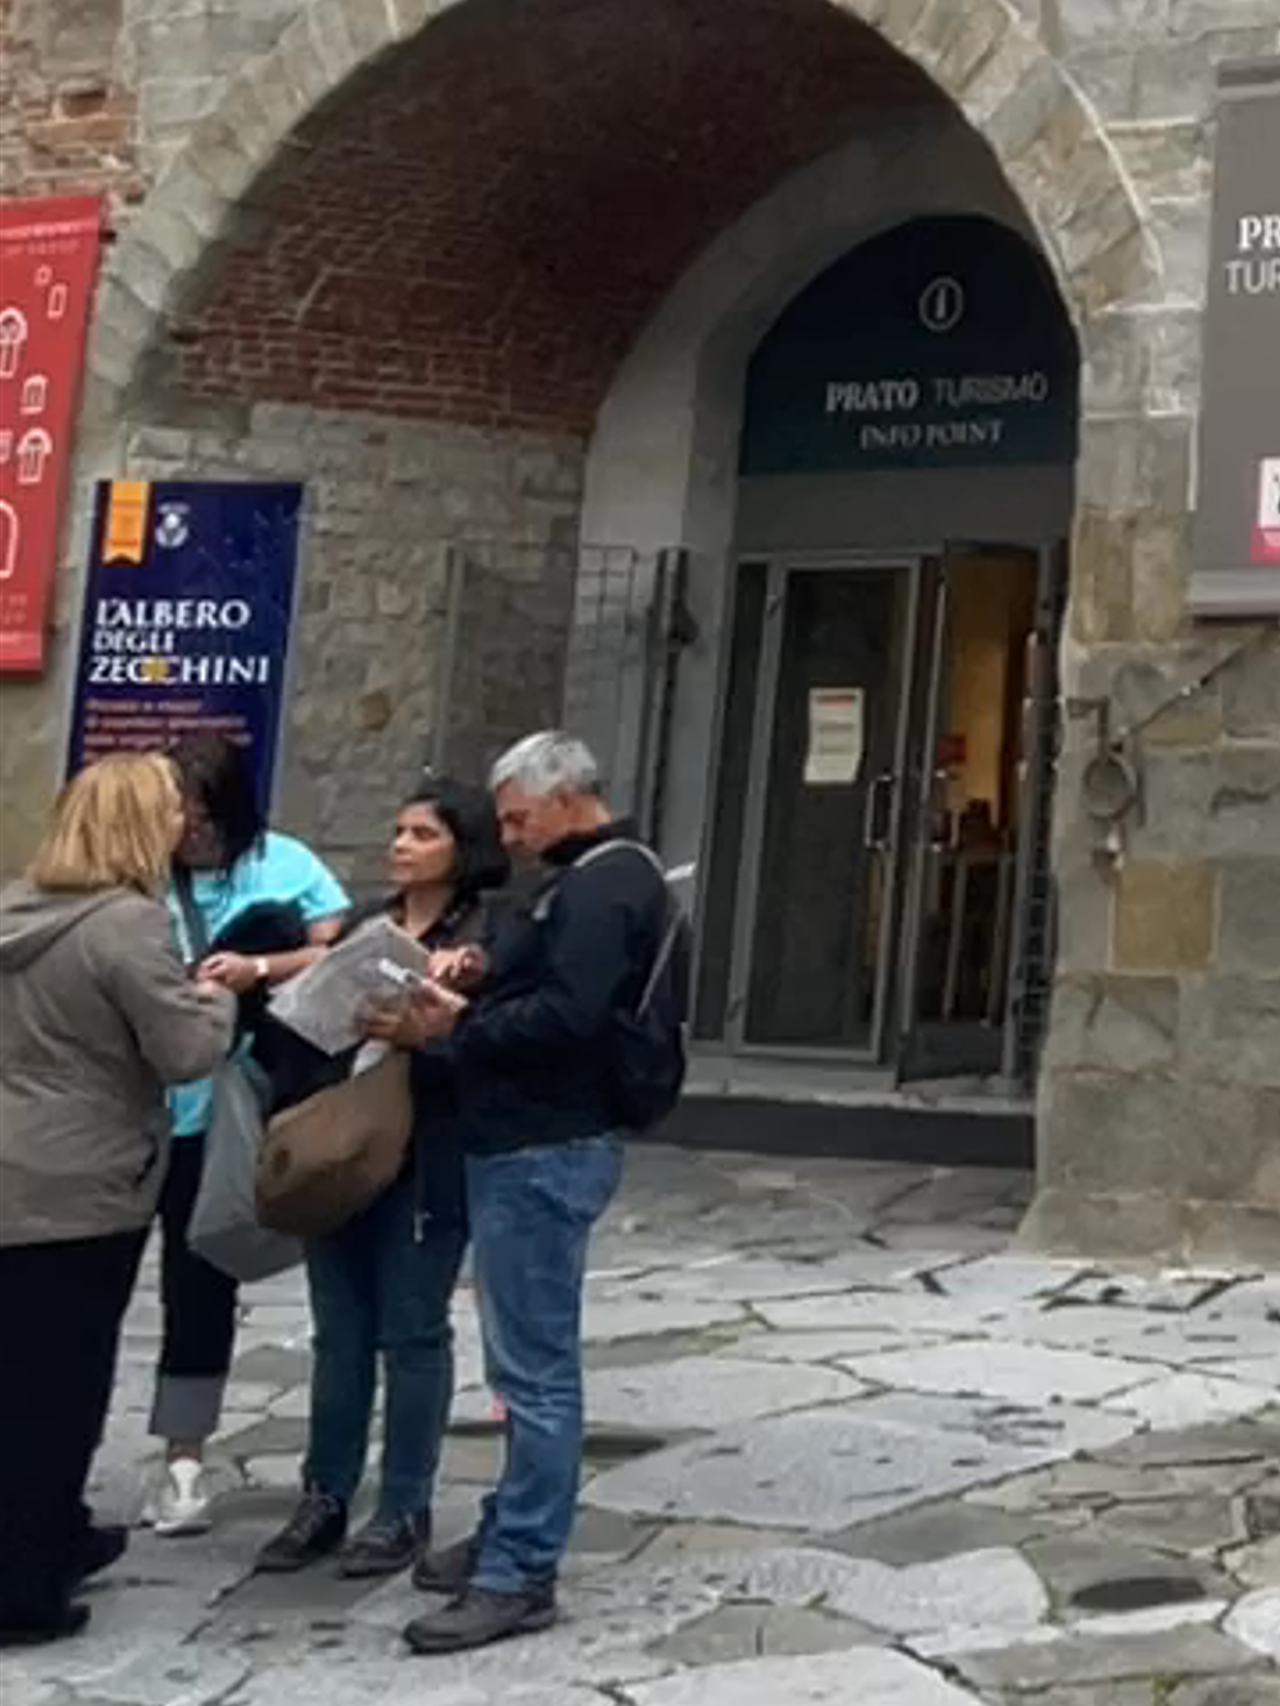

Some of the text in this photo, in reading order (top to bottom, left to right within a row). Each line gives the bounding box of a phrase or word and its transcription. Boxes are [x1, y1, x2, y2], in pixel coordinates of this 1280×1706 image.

[826, 371, 1049, 412] PRATO TURISMO
[861, 419, 1003, 450] INFO POINT
[93, 630, 175, 654] DEGLI
[88, 655, 270, 685] ZECCHINI
